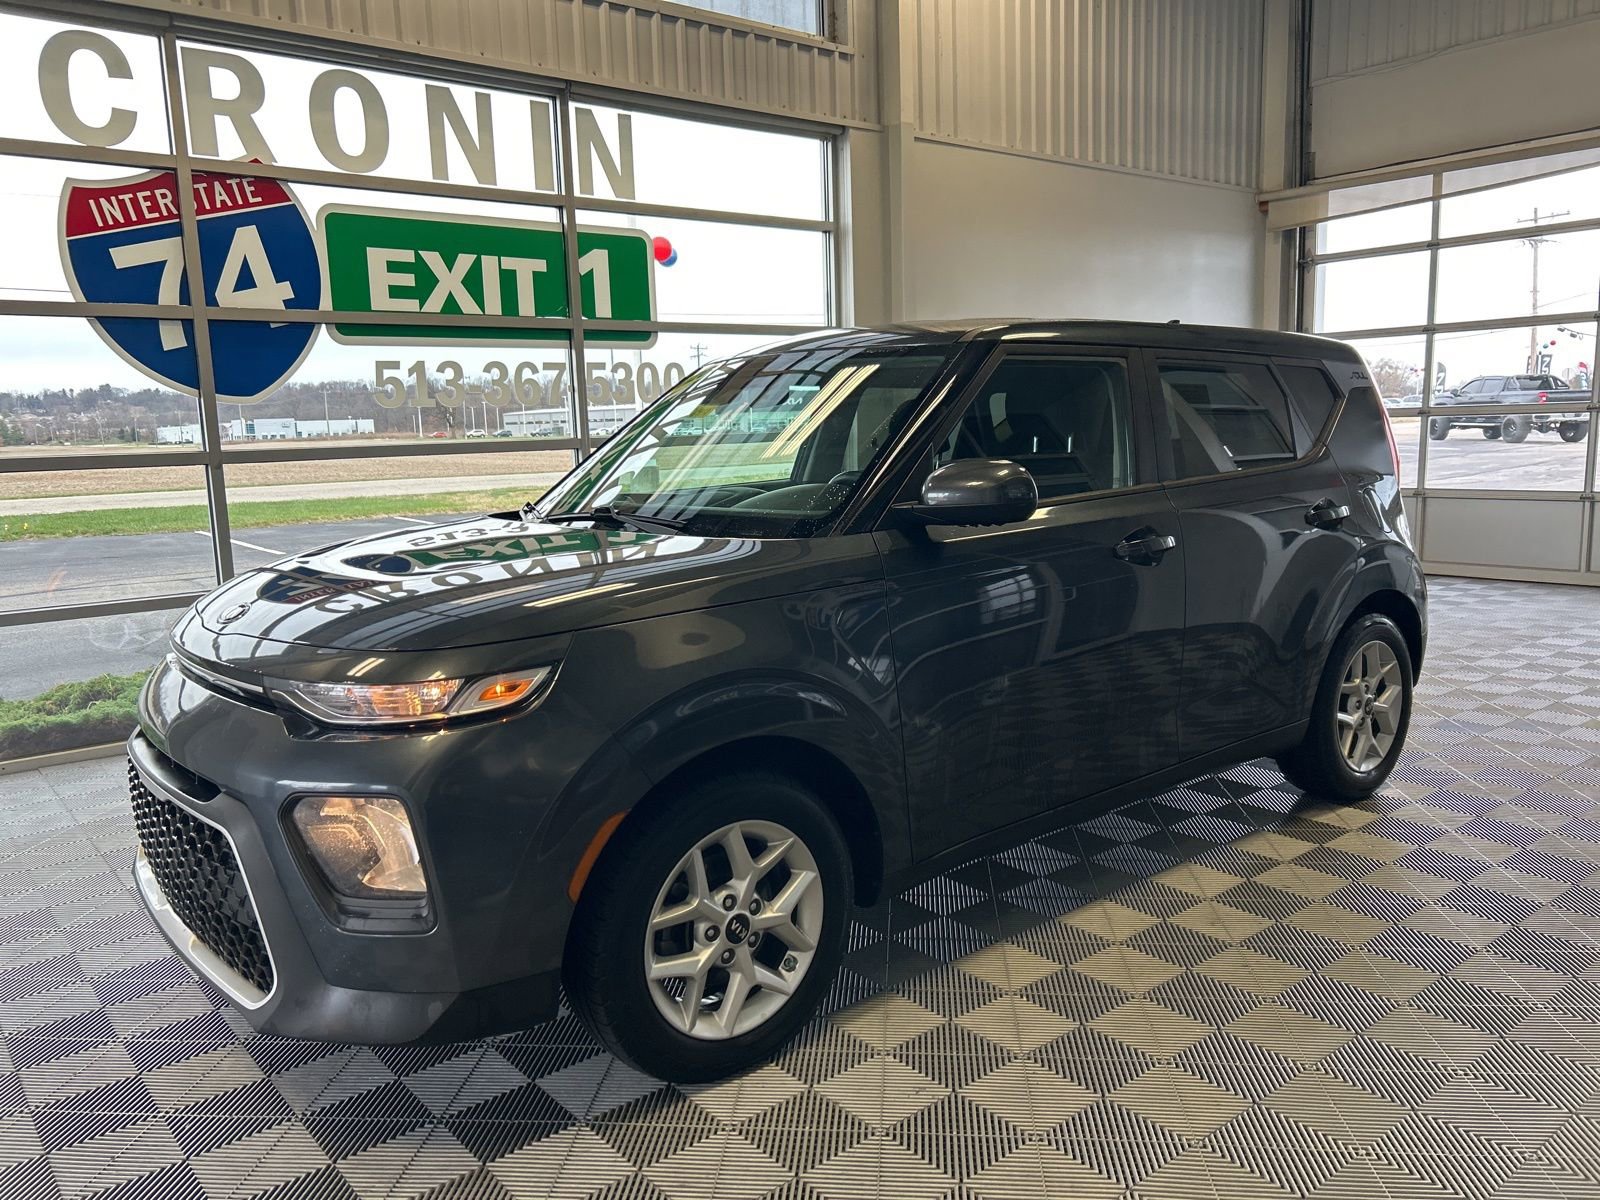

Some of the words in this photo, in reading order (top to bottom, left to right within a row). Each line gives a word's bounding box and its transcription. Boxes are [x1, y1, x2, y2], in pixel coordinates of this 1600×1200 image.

[38, 30, 636, 200] CRONIN
[88, 177, 263, 228] INTERTATE
[108, 224, 295, 351] 74
[366, 246, 548, 317] EXIT
[578, 248, 612, 319] 1
[374, 360, 686, 409] 513-3675300
[731, 919, 748, 940] KIA
